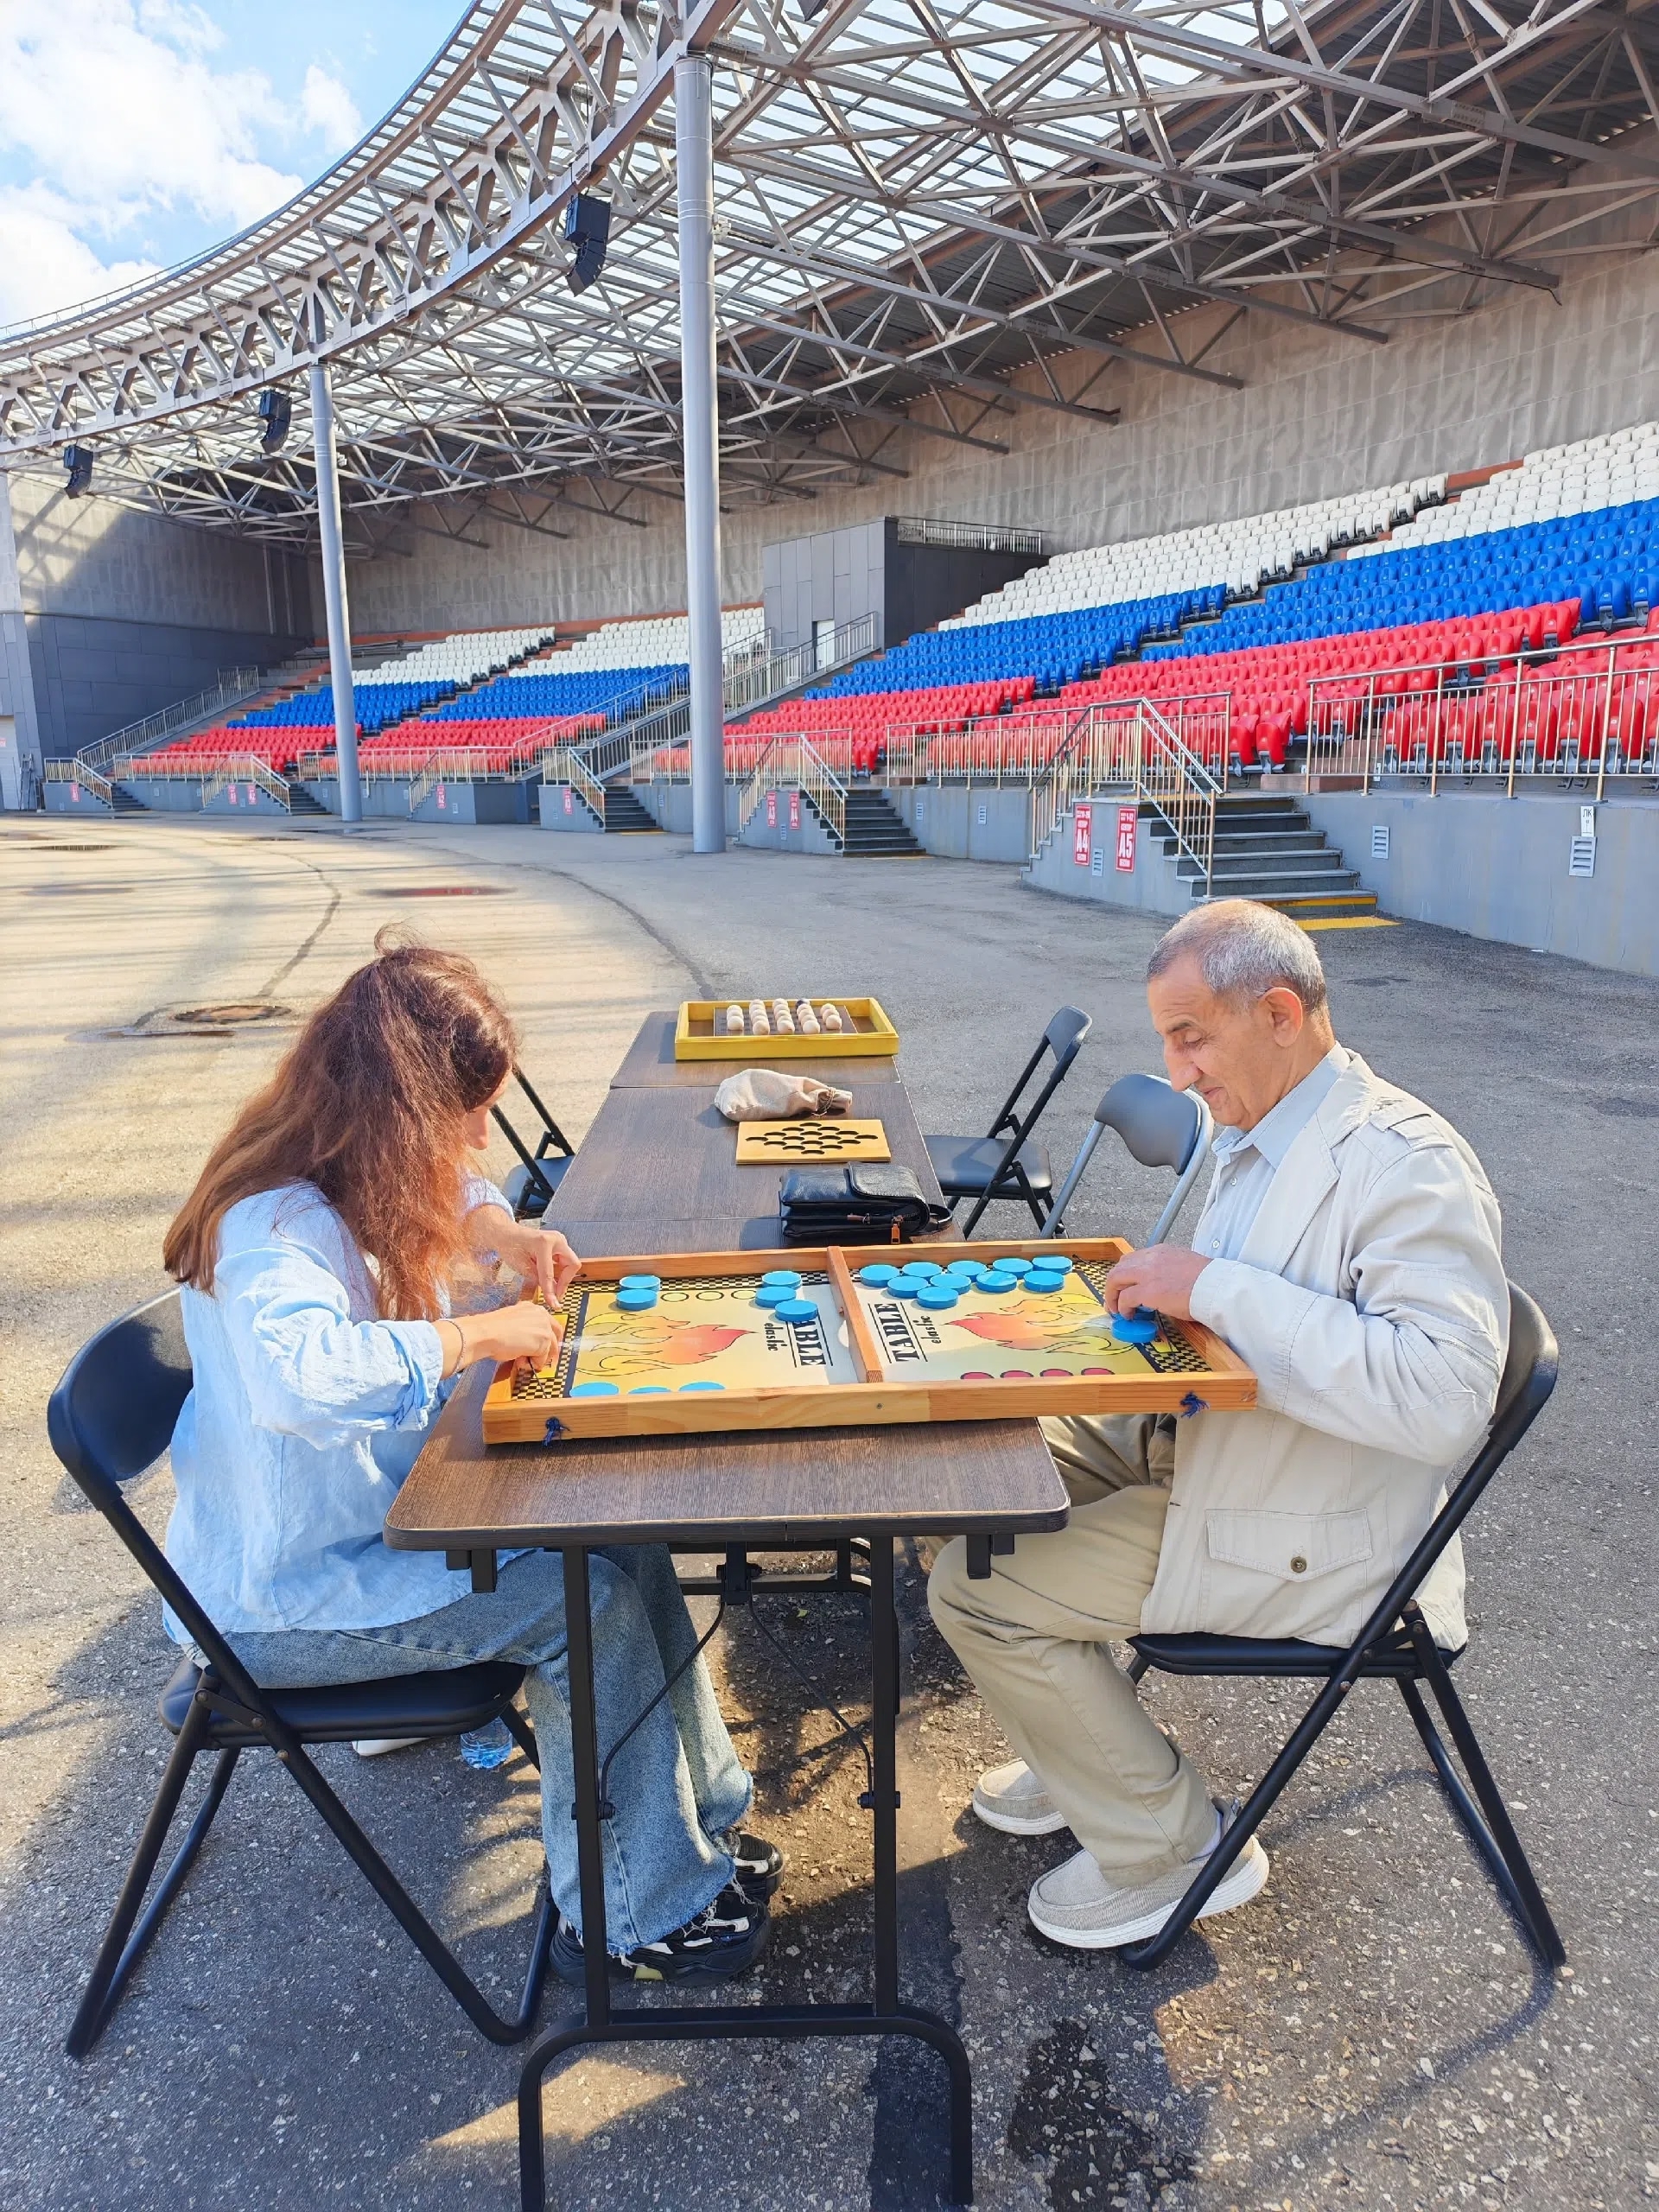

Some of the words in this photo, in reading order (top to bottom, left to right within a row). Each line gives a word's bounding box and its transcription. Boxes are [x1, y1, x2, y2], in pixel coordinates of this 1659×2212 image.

[1077, 829, 1088, 852] A4
[1118, 832, 1133, 858] A5
[764, 1323, 788, 1351] elastic
[792, 1321, 826, 1366] ABLE
[874, 1303, 920, 1363] TABLE
[912, 1315, 942, 1344] elastic
